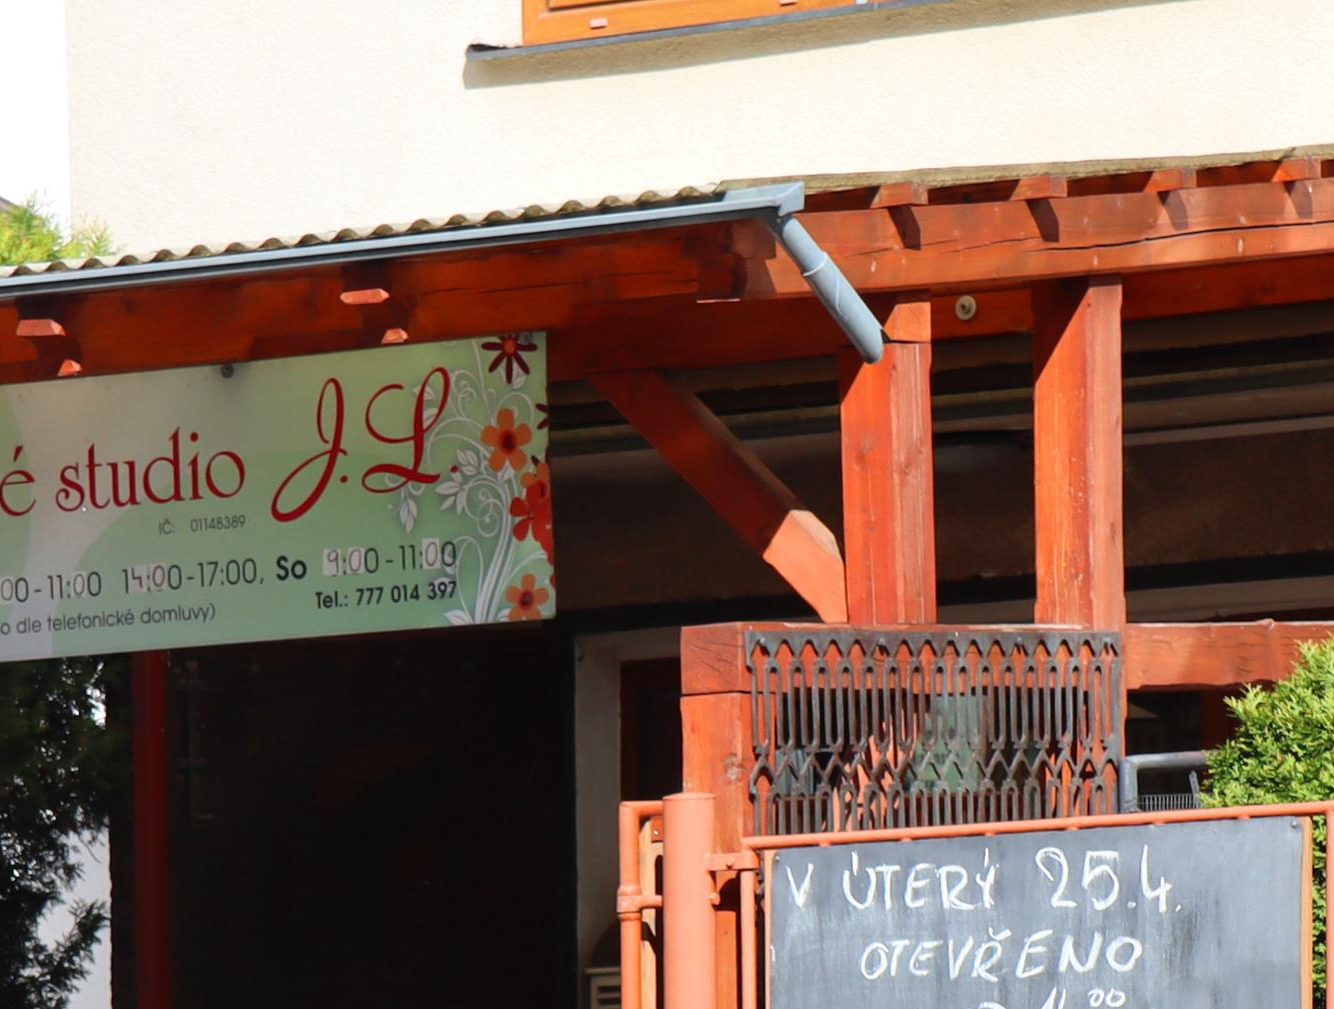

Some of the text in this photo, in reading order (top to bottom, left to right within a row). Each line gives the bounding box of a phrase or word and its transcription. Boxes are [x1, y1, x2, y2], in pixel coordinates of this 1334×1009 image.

[55, 426, 246, 512] studio
[190, 514, 246, 533] 01148389
[275, 555, 307, 580] So
[315, 581, 456, 609] Tel.: 777 014 397
[16, 617, 42, 634] dle
[47, 609, 134, 631] telefonické
[141, 603, 216, 625] domluvy)
[785, 844, 1182, 912] V ÚTERÝ 25.4.
[859, 928, 1143, 983] OTEVŘENO
